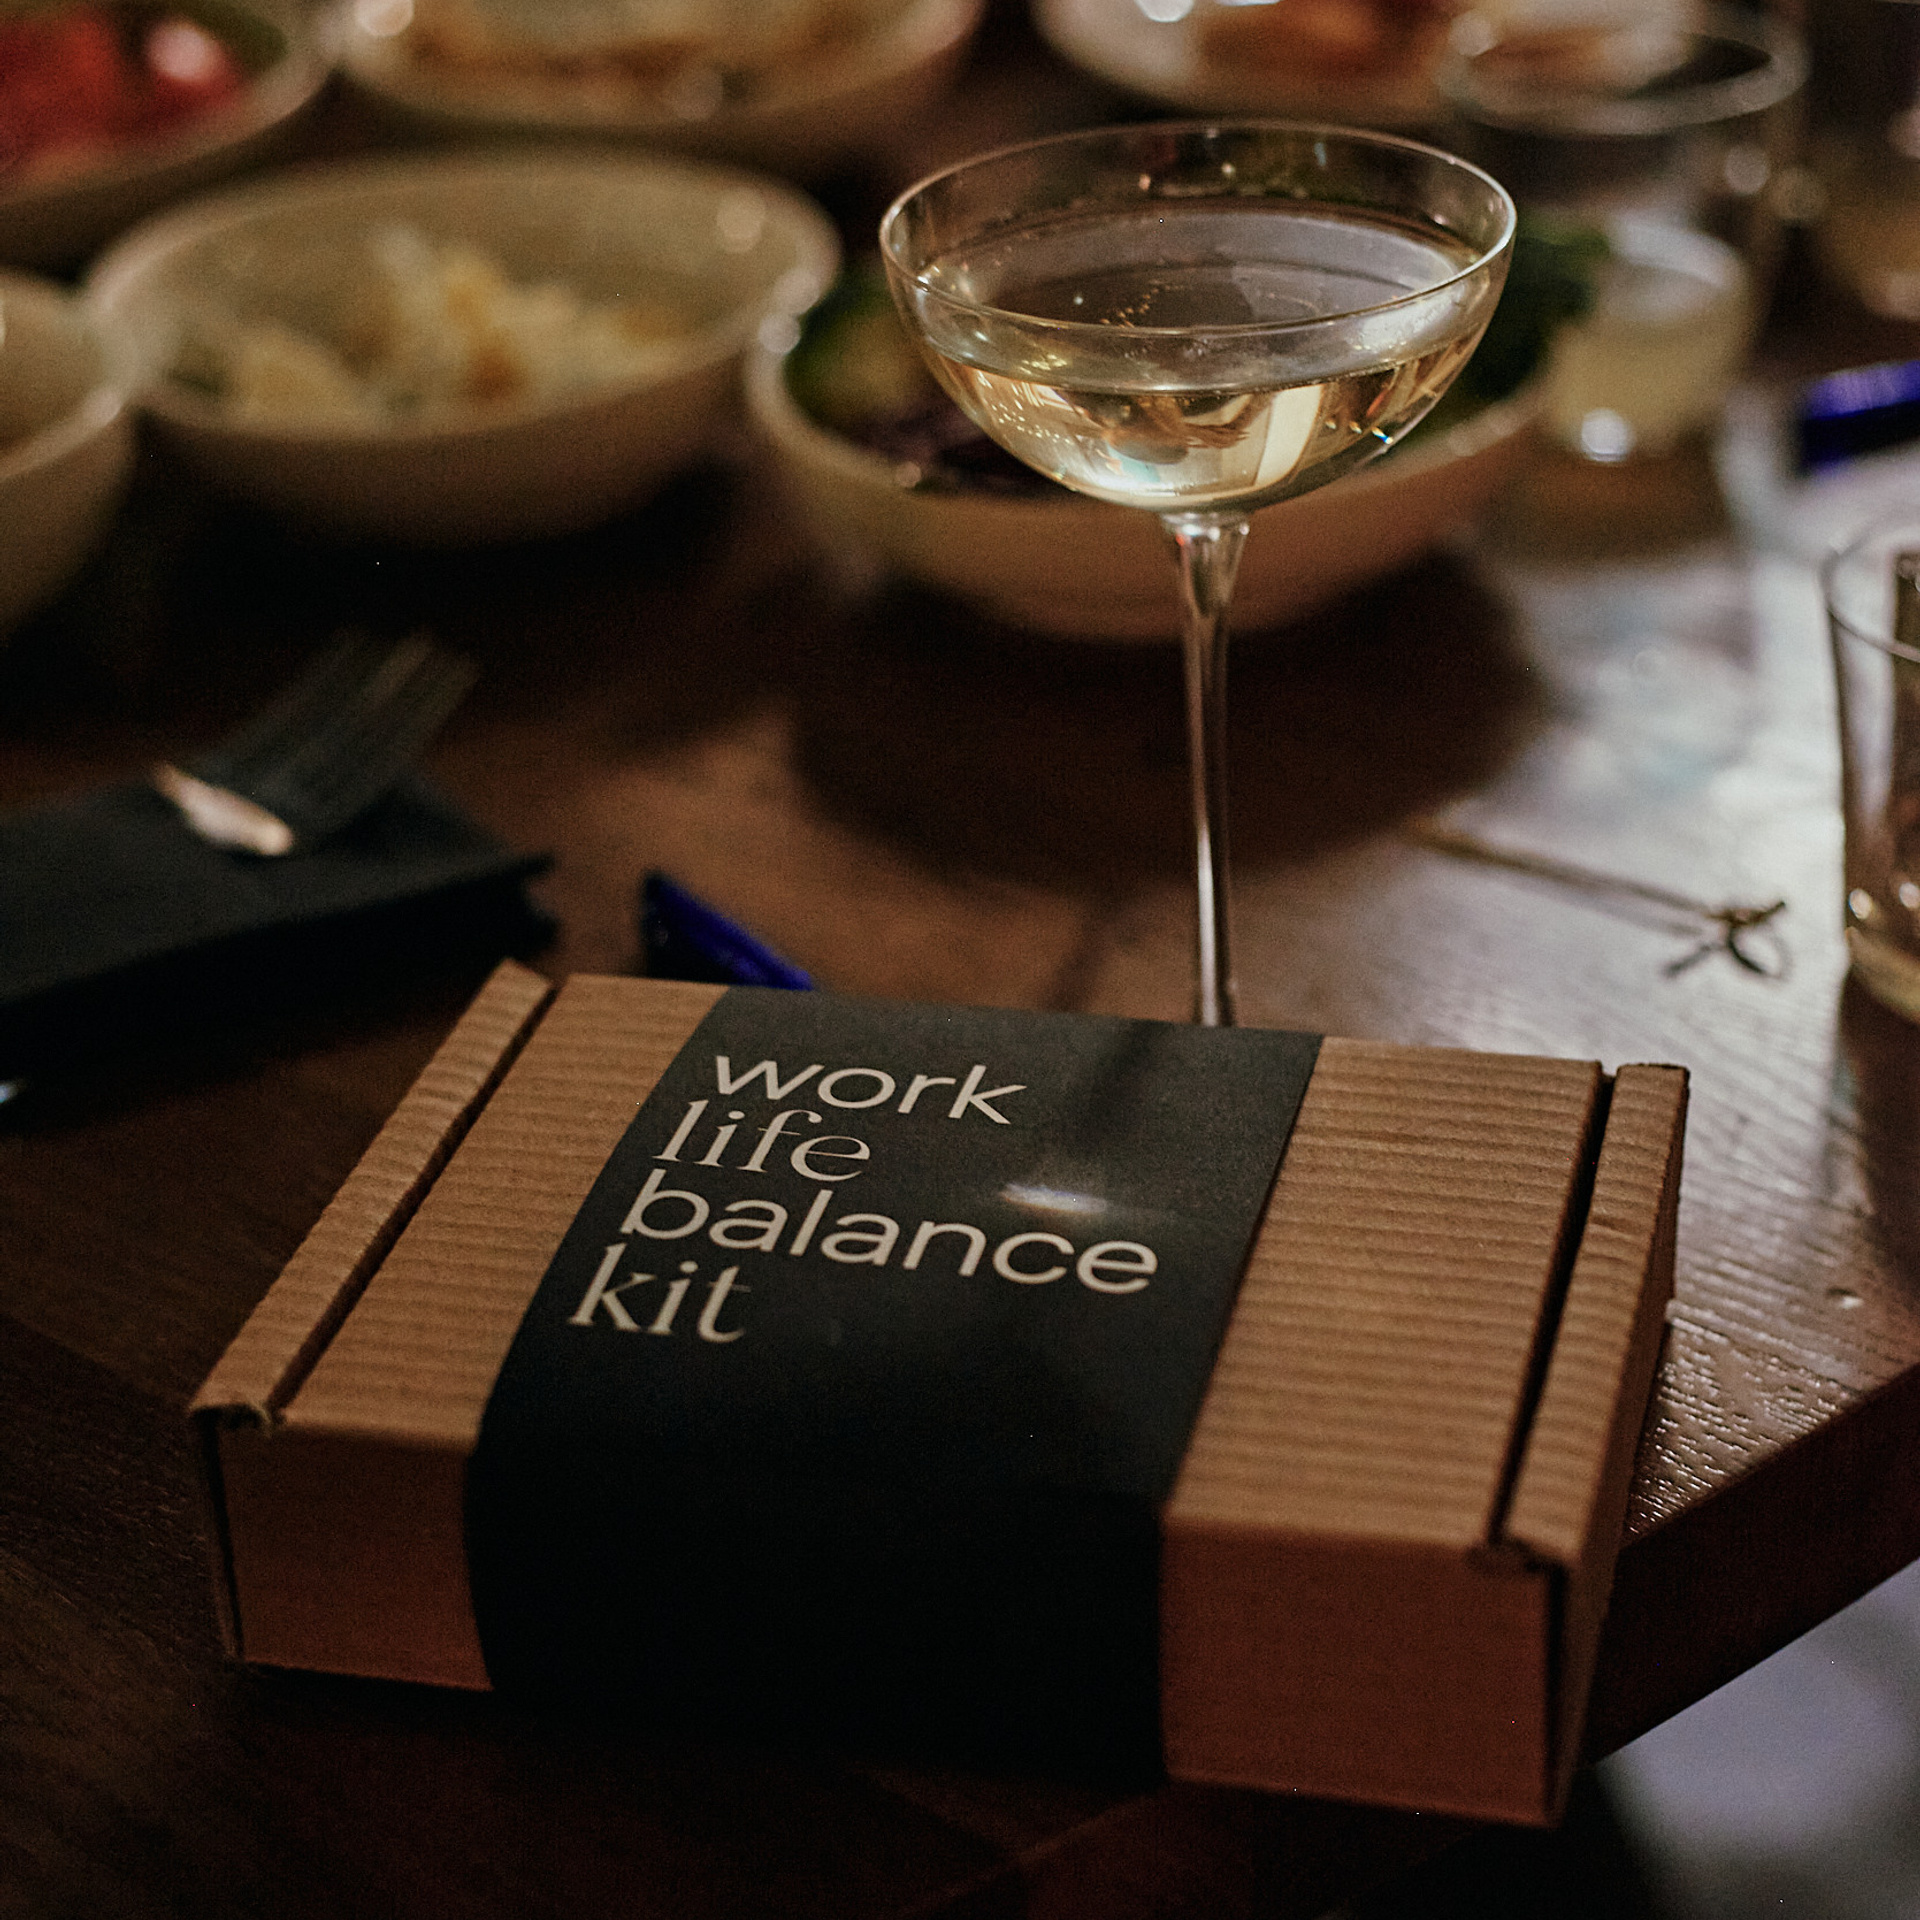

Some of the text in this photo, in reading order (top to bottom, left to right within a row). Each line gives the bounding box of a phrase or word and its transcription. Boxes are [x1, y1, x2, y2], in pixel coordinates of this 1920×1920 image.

[716, 1055, 1027, 1124] work
[652, 1099, 871, 1181] life
[620, 1168, 1158, 1294] balance
[569, 1242, 751, 1343] kit
